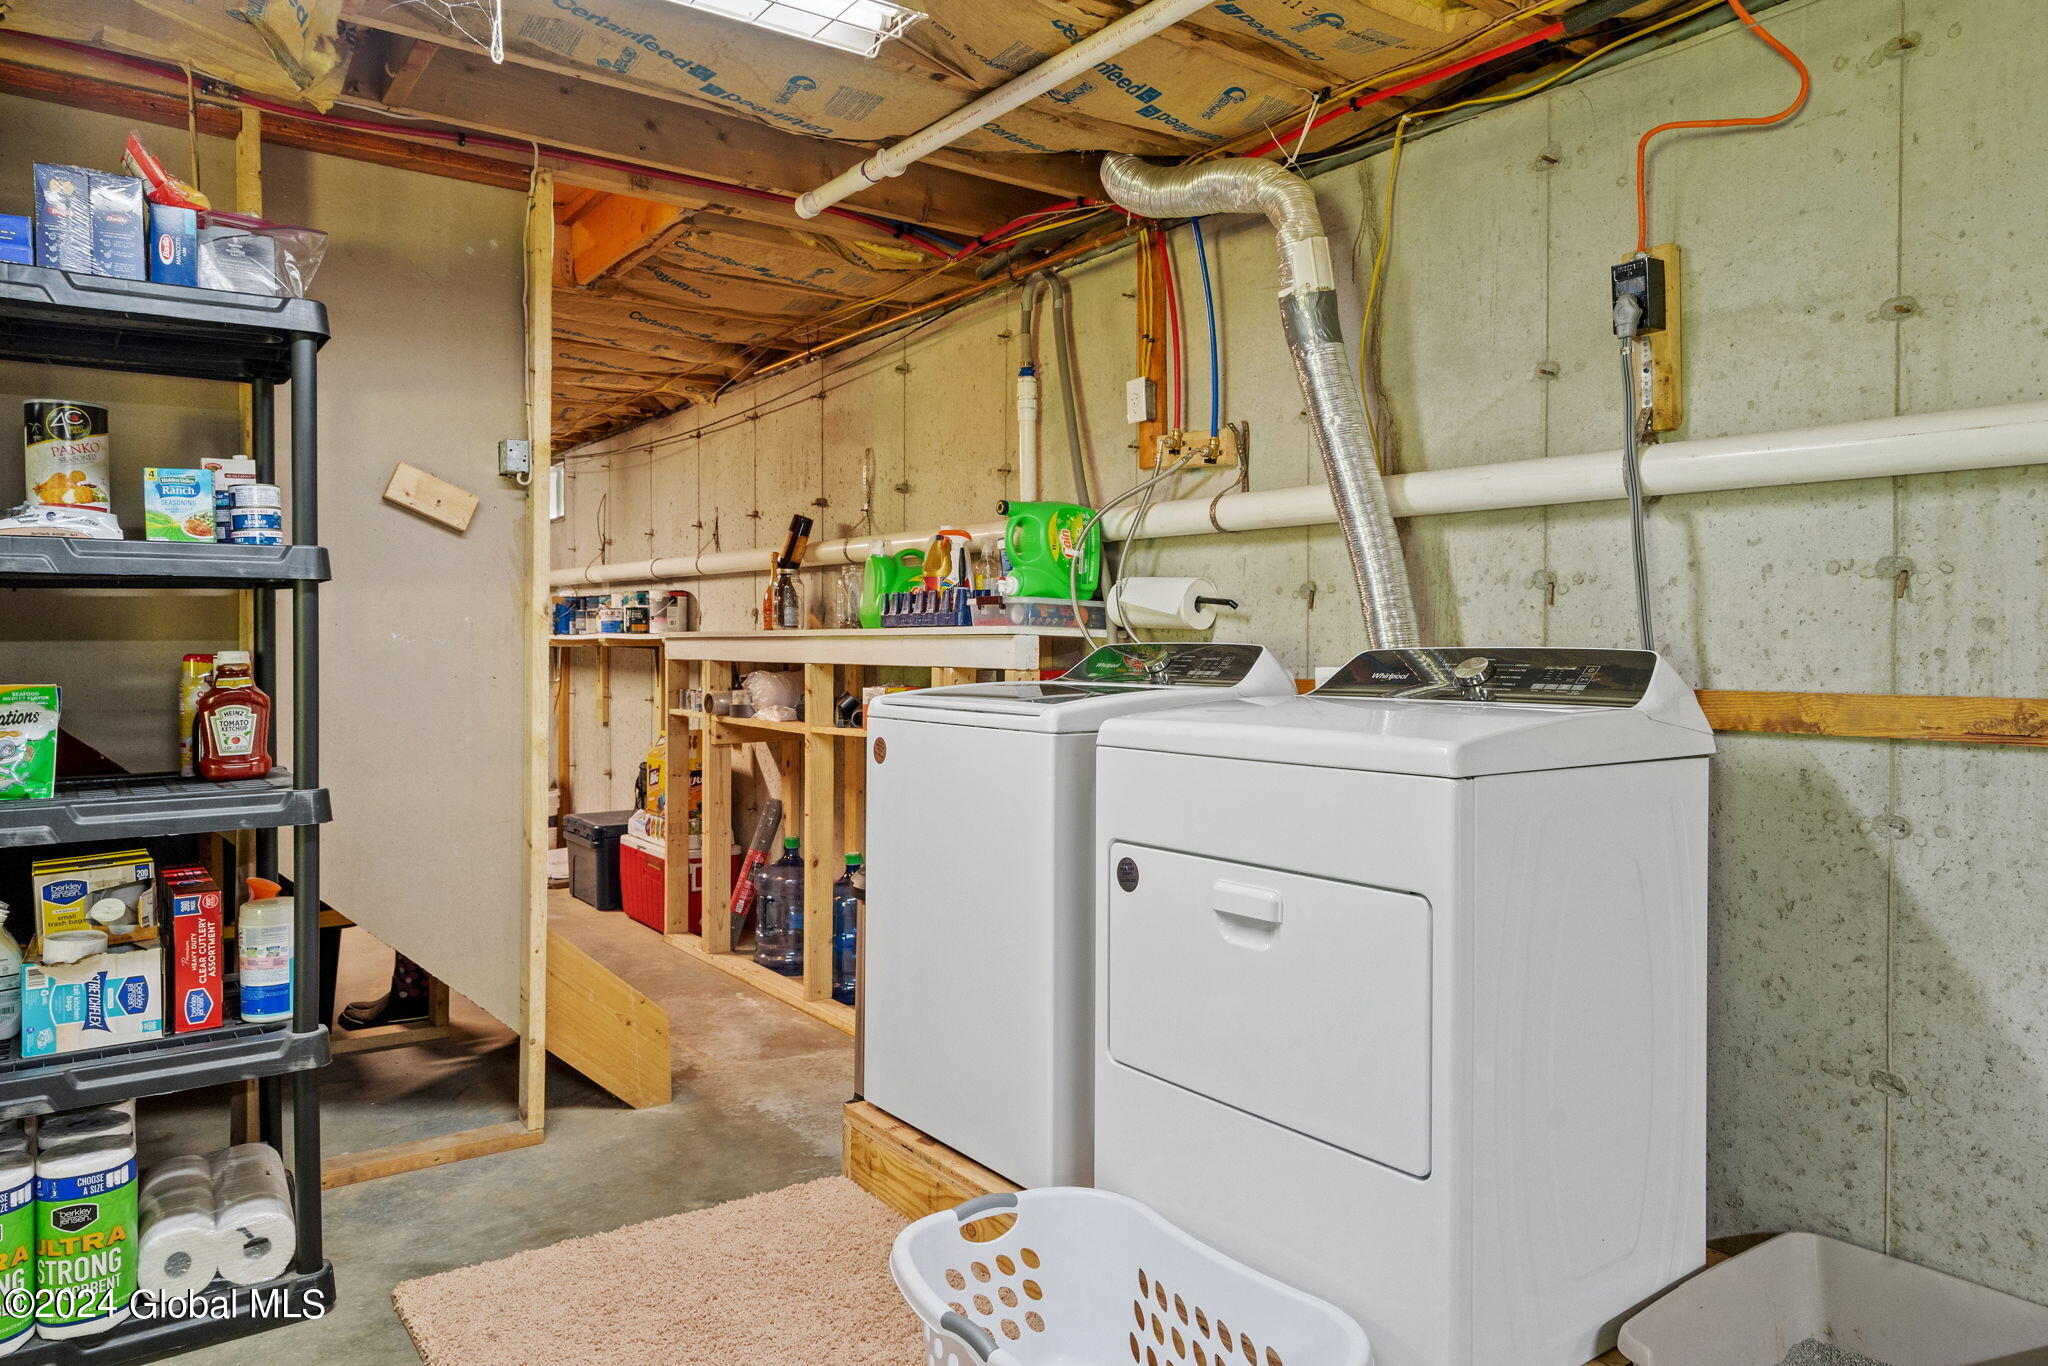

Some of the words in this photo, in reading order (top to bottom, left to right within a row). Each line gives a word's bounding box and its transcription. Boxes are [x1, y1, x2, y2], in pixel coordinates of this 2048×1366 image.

[552, 0, 694, 70] CertainTeed
[50, 410, 84, 439] 4C
[50, 442, 100, 457] PANKO
[58, 454, 97, 464] SEASONED
[162, 486, 195, 495] Ranch
[1371, 672, 1409, 681] Whirlpool
[0, 709, 40, 726] ations
[219, 719, 249, 728] TOMATO
[136, 868, 149, 878] 200
[50, 883, 82, 893] berkley
[50, 890, 82, 901] jensen
[57, 913, 77, 921] small
[47, 920, 67, 928] trash
[208, 921, 216, 977] ASSORTMENT
[125, 983, 136, 1010] jensen
[135, 982, 145, 1009] berkley
[77, 1173, 104, 1187] CHOOSE
[83, 1187, 89, 1196] A
[90, 1184, 105, 1195] SIZE
[60, 1207, 92, 1219] berkley
[60, 1215, 91, 1227] jensen
[37, 1247, 122, 1286] STRONG
